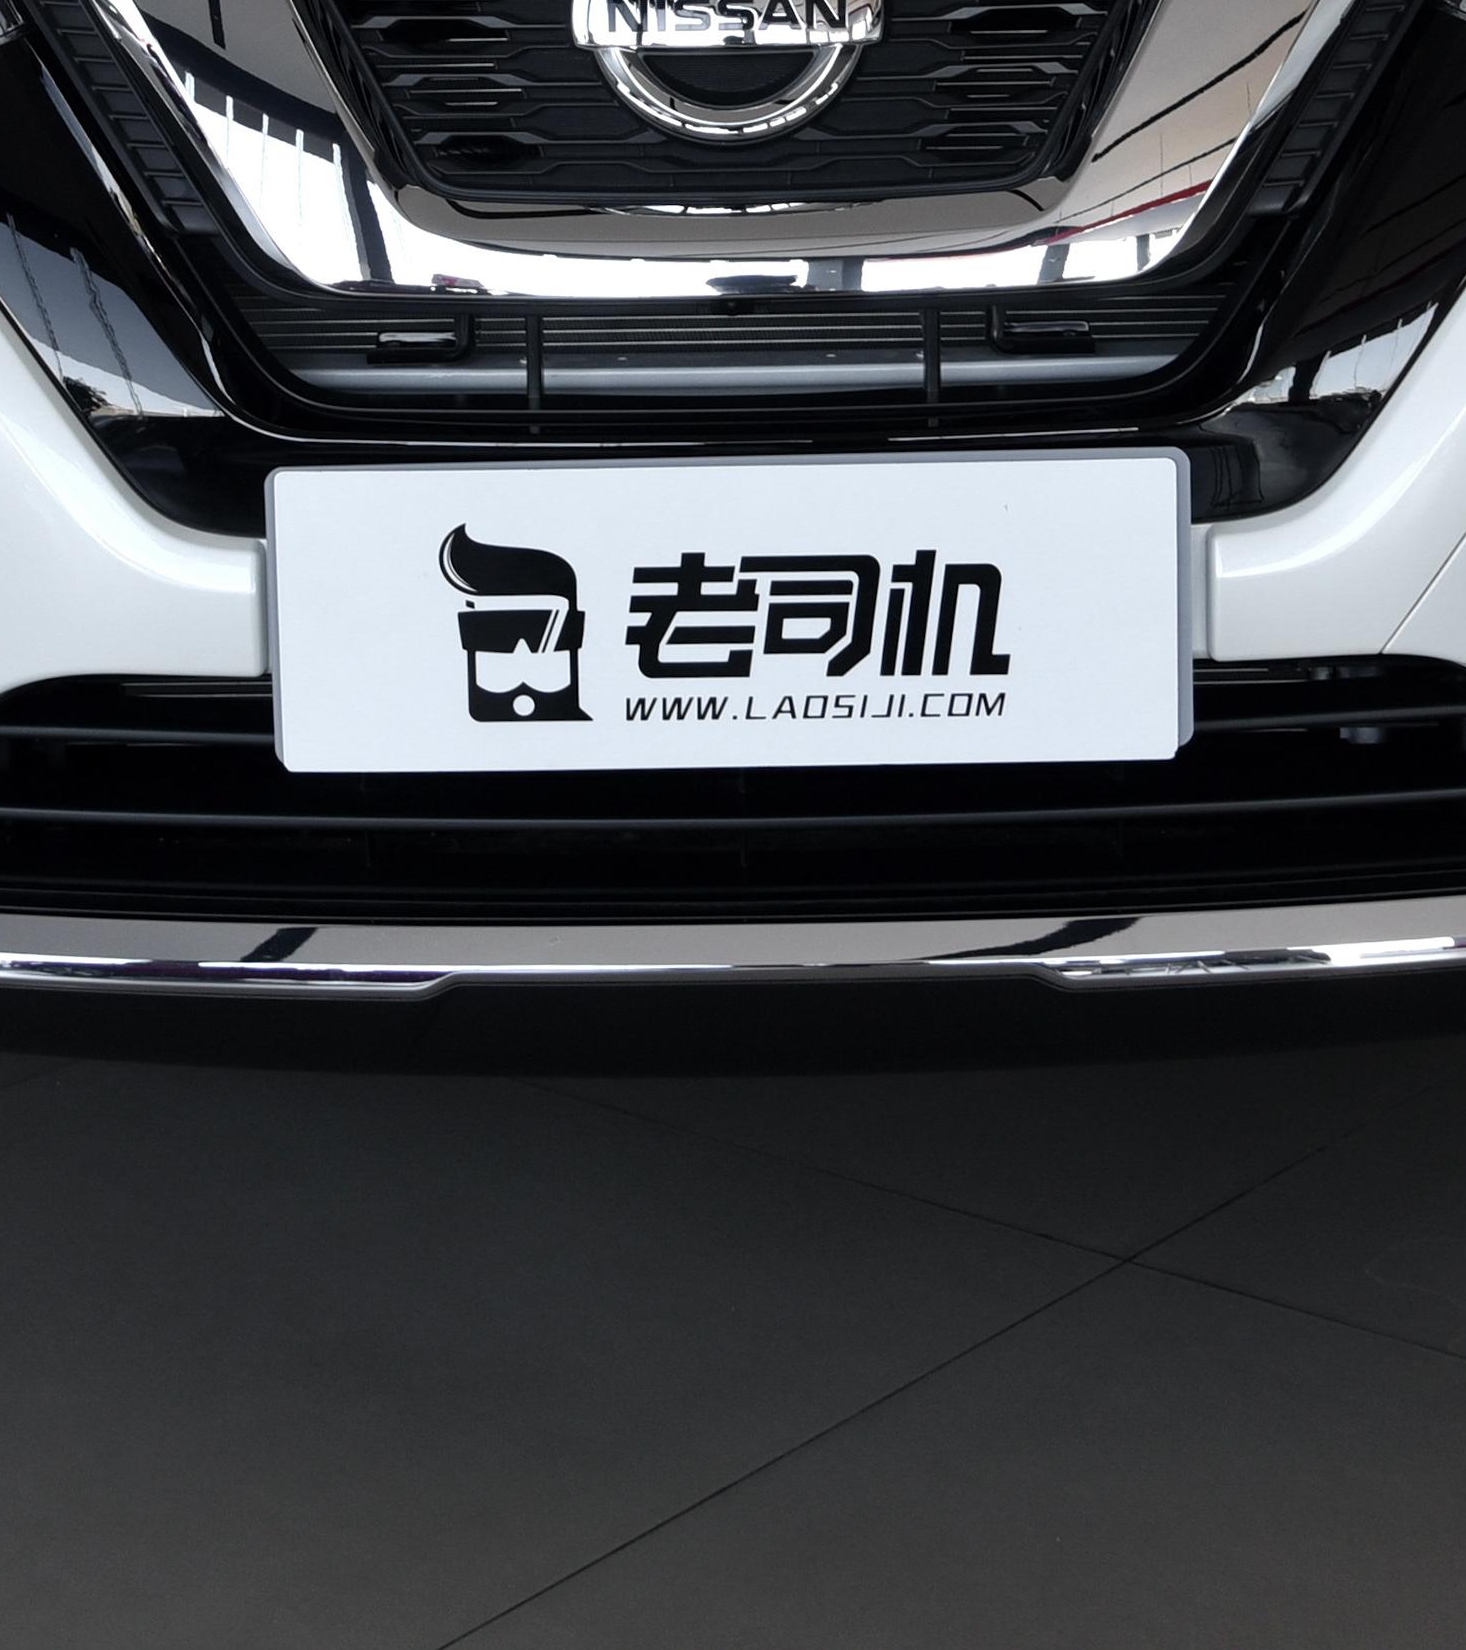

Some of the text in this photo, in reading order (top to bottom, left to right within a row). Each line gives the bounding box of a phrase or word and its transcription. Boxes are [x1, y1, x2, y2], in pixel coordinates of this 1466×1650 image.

[626, 549, 1011, 678] 老司机
[626, 692, 1006, 722] WWW.LAOSIJI.COM
